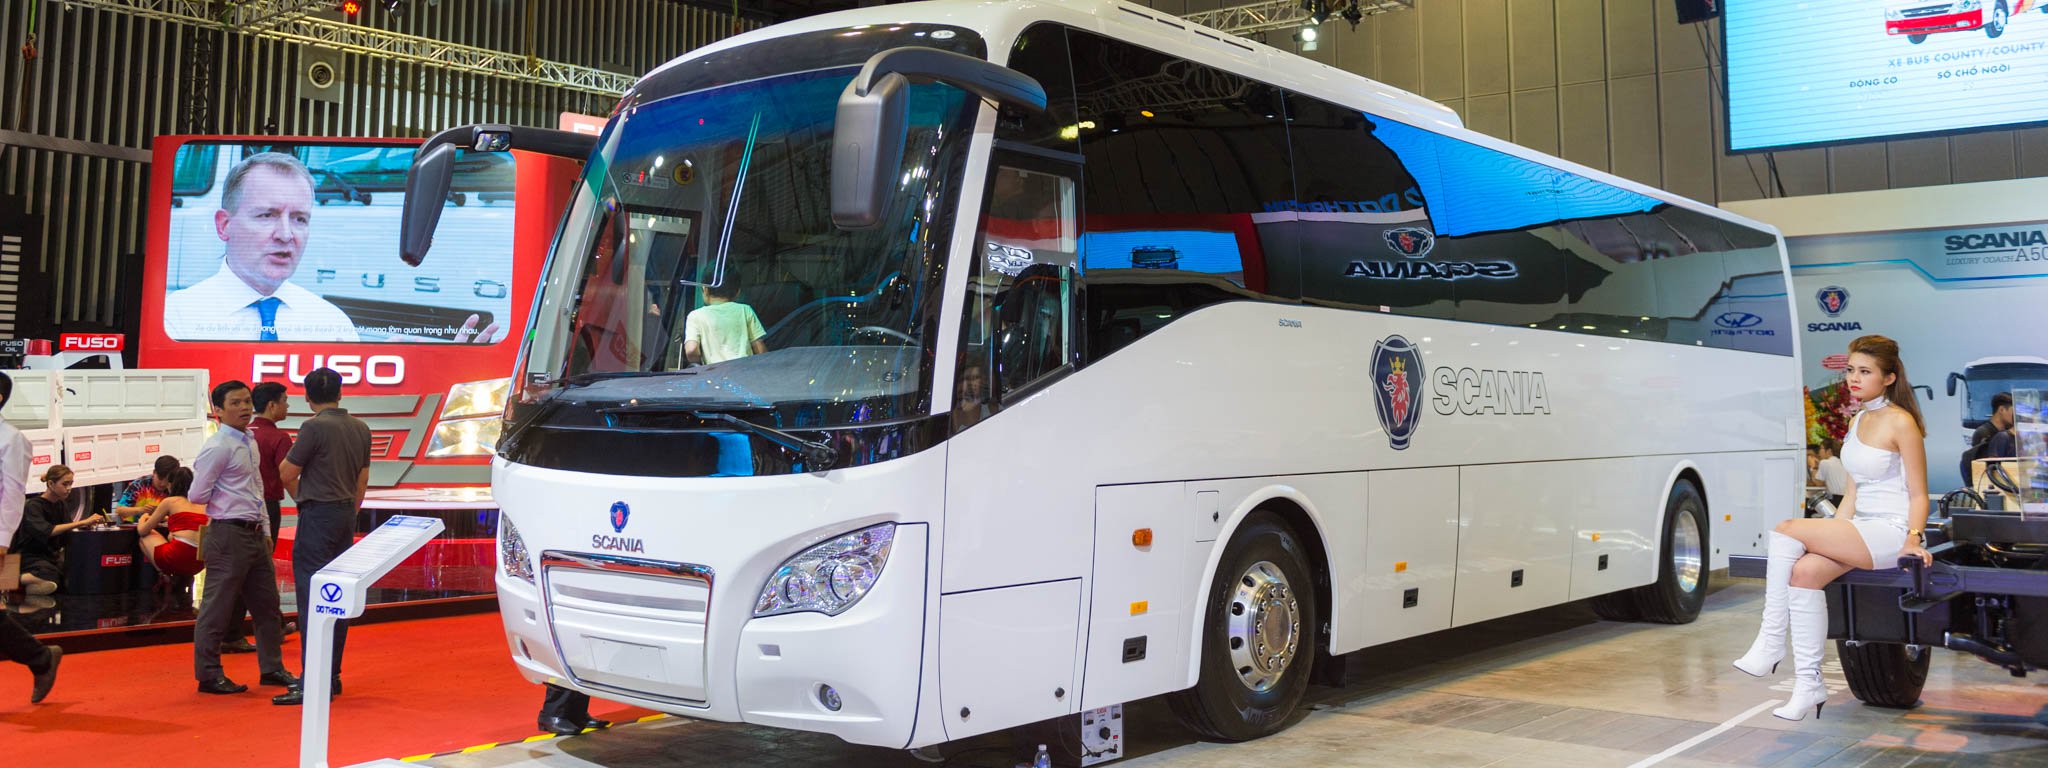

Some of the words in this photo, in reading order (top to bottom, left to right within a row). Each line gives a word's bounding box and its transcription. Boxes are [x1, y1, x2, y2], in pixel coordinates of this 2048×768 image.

[1907, 55, 1931, 66] BUS
[1944, 230, 2048, 251] SCANIA
[1946, 257, 1981, 266] LUXURY
[1983, 255, 2015, 264] COACH
[403, 327, 423, 336] quan
[1807, 321, 1863, 332] SCANIA
[65, 336, 118, 348] FUSO
[252, 354, 405, 385] FUSO
[1432, 366, 1551, 416] SCANIA
[592, 534, 645, 553] SCANIA
